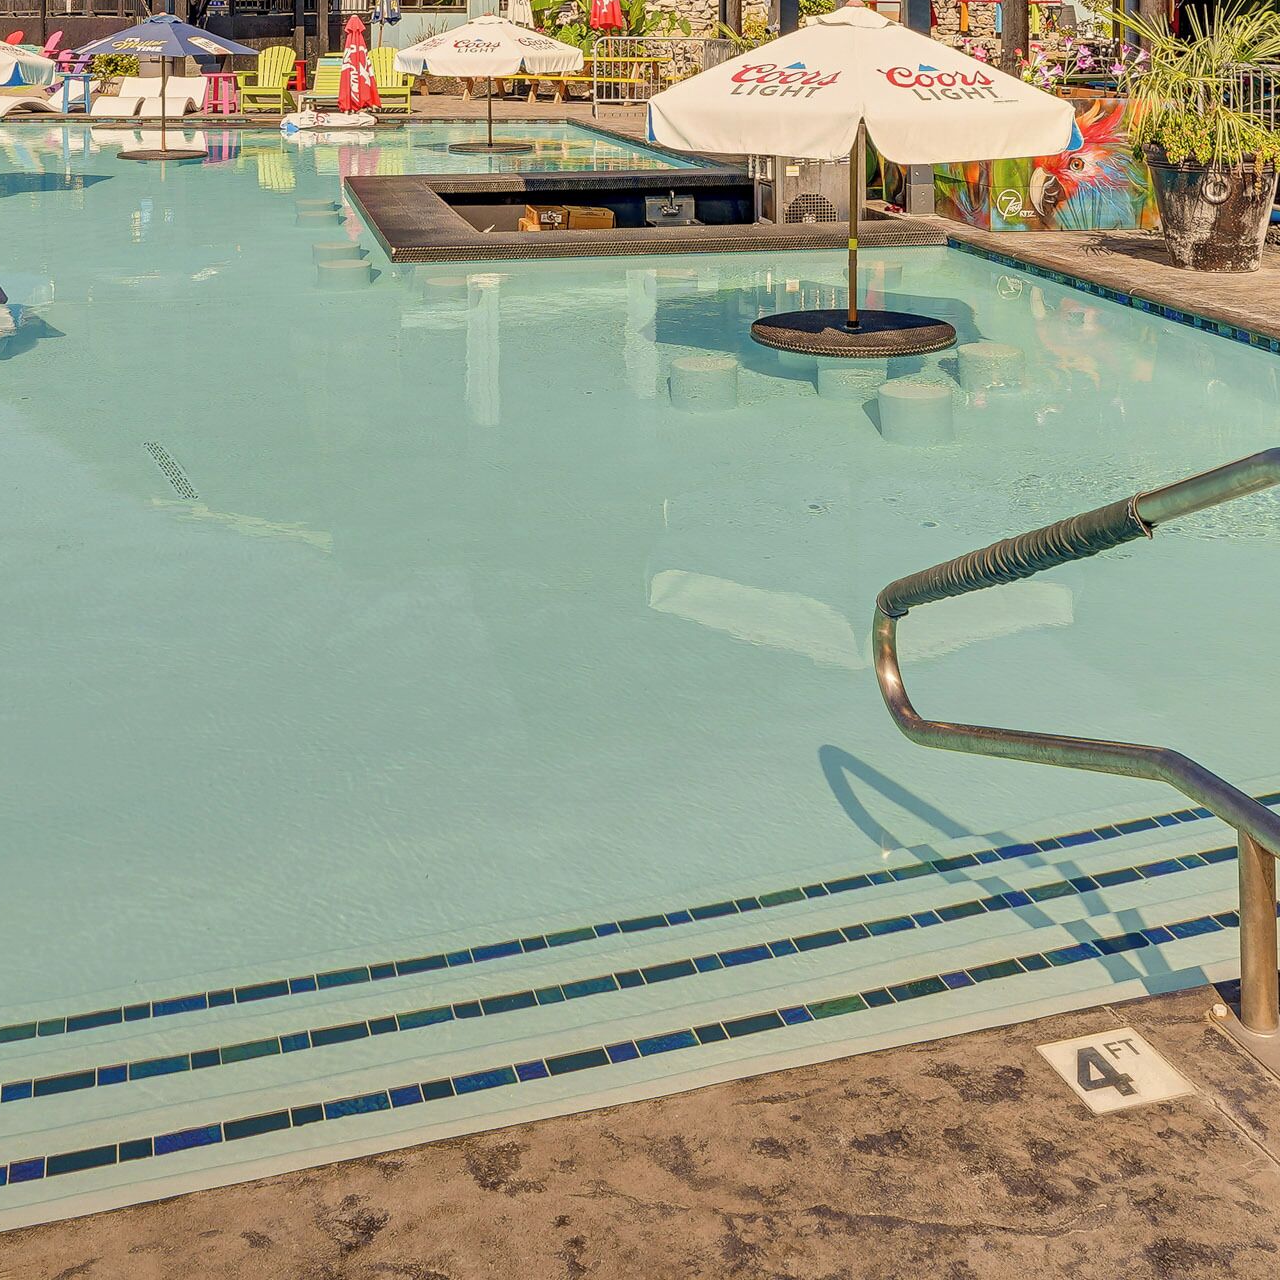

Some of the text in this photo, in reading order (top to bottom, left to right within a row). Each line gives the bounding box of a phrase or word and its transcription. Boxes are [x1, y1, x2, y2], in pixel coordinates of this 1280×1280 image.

[111, 39, 169, 51] Miller
[453, 38, 502, 49] Coors
[514, 37, 554, 47] Coors
[731, 63, 842, 85] Coors
[876, 66, 995, 88] Coors
[730, 83, 823, 98] LIGHT
[911, 87, 1000, 101] LIGHT
[1077, 1038, 1140, 1097] 4 FT
